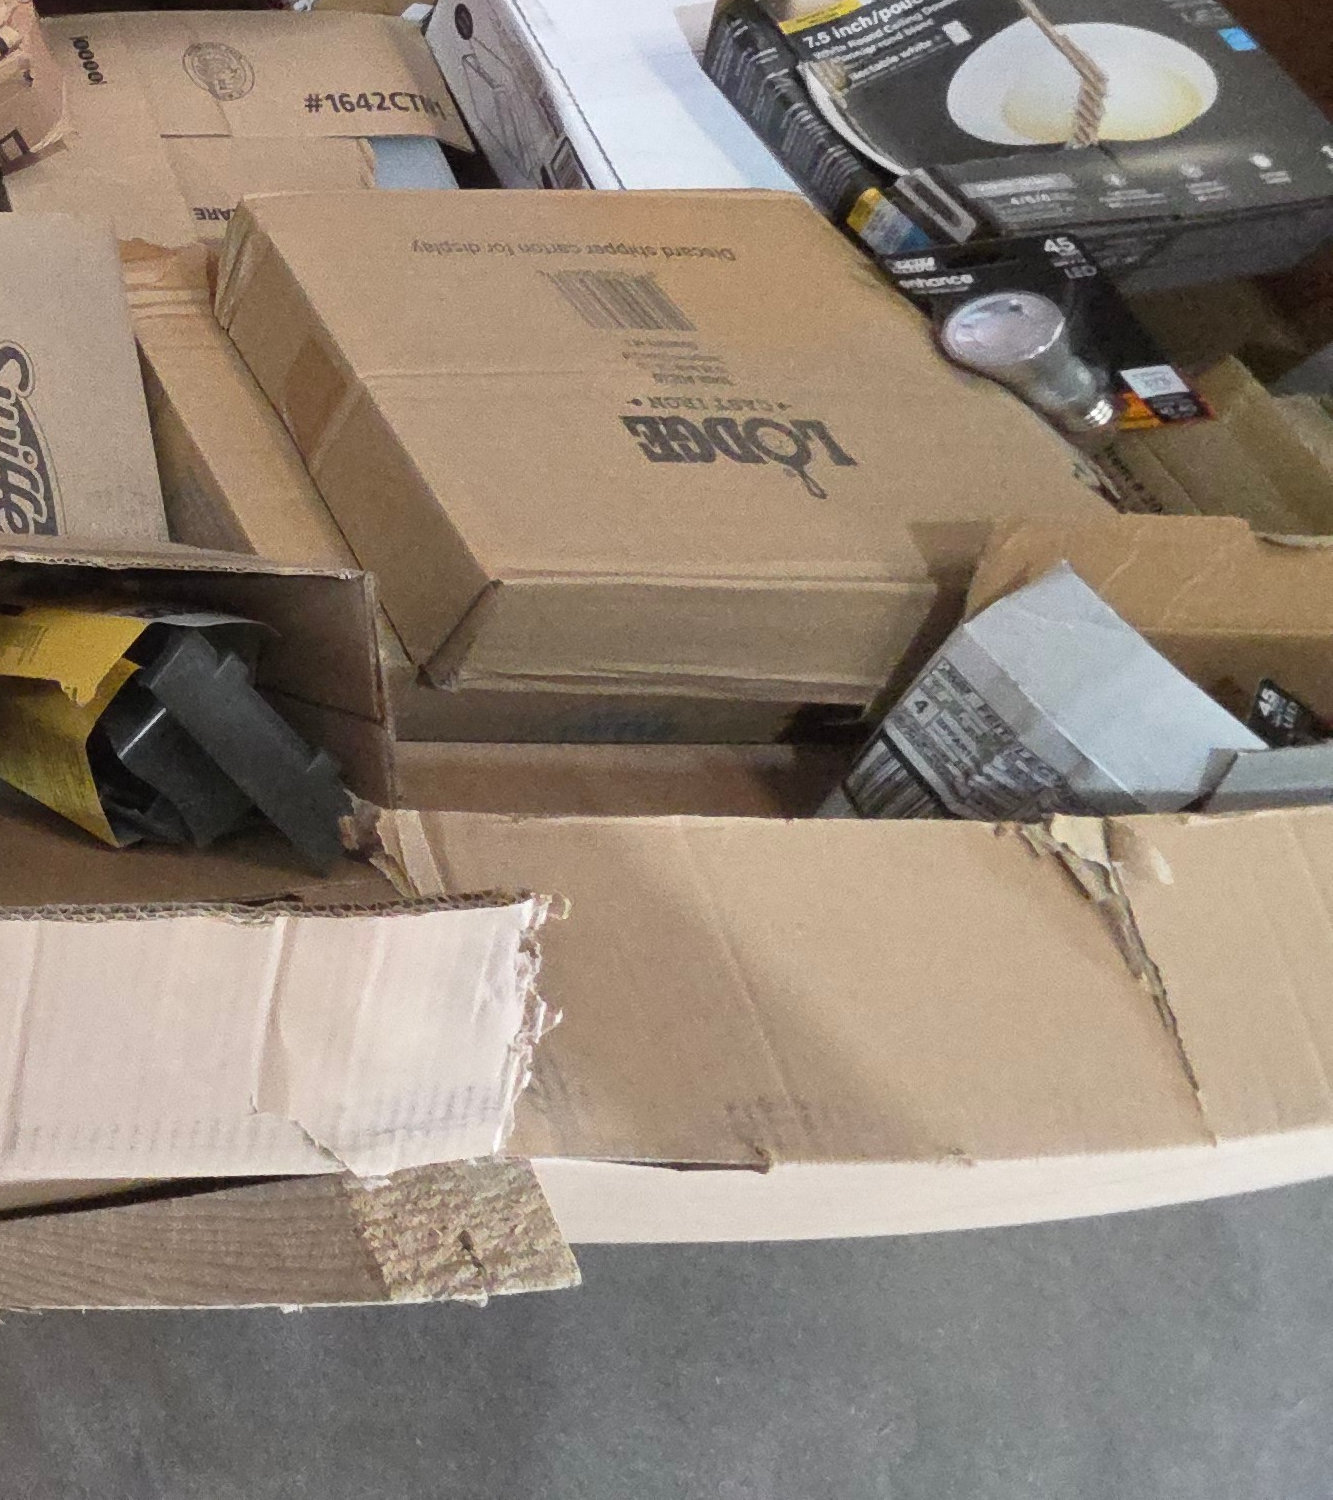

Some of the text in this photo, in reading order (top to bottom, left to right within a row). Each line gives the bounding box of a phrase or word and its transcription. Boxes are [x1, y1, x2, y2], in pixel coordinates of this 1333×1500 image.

[802, 32, 830, 49] 7.5
[899, 274, 974, 290] enhance
[620, 415, 858, 480] LODGE
